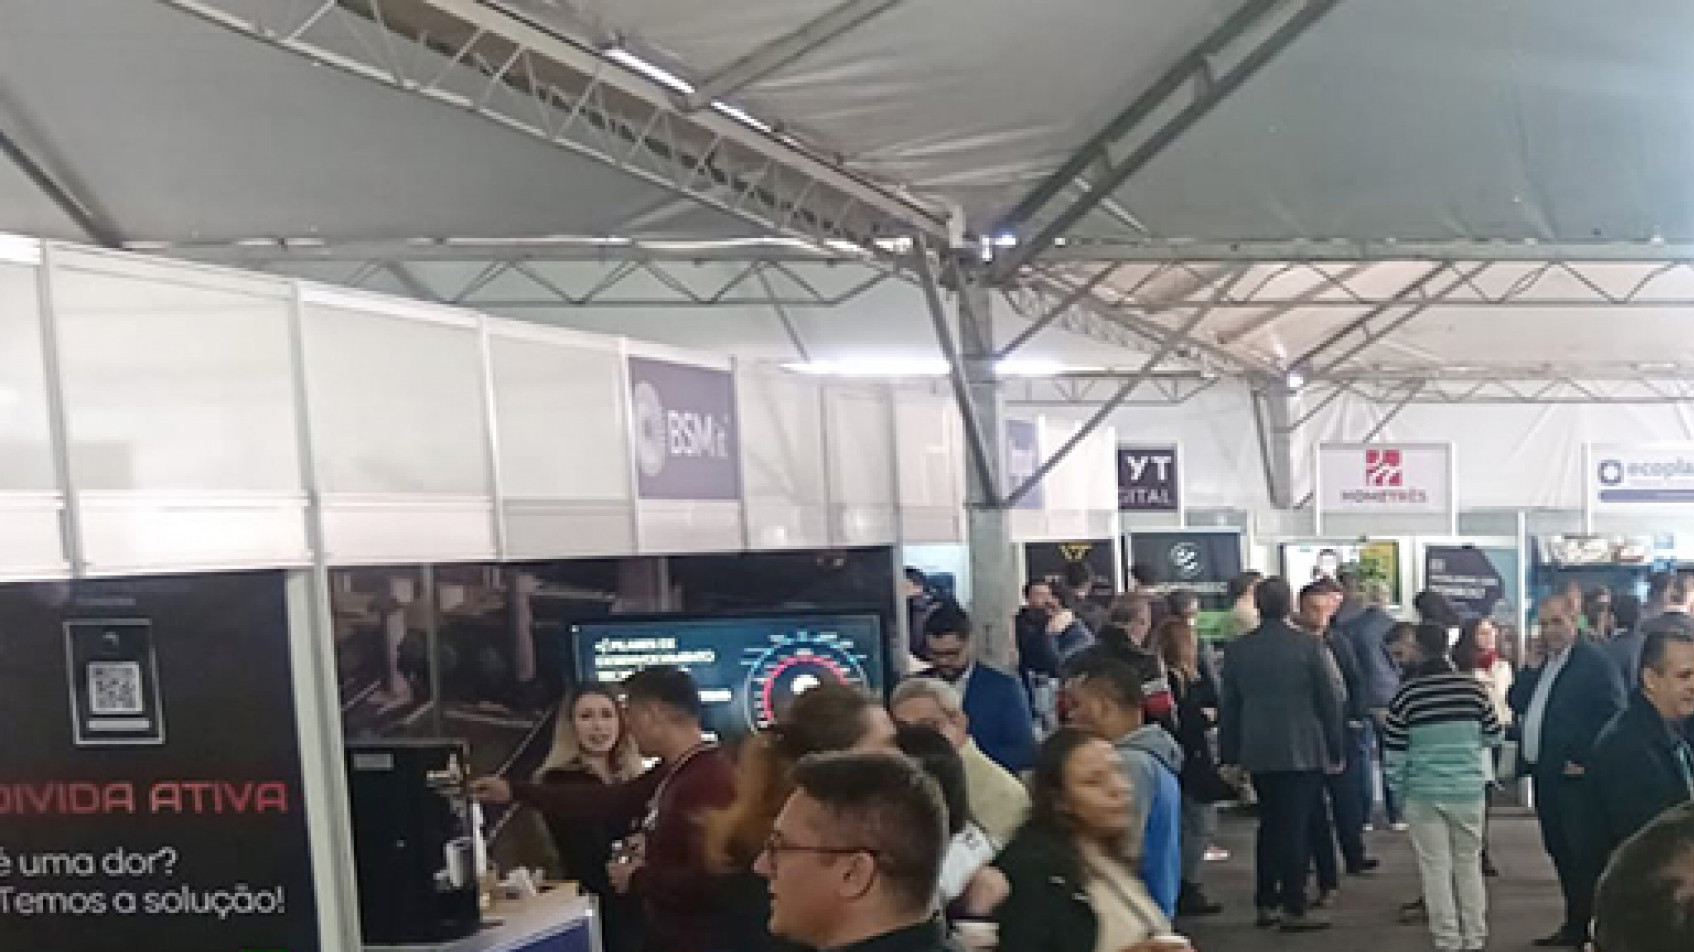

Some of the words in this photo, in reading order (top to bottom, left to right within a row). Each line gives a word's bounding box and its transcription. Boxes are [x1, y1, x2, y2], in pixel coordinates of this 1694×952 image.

[150, 780, 289, 814] ATIVA
[19, 853, 95, 877] uma
[102, 846, 179, 877] dor?
[0, 886, 107, 915] Temos
[114, 891, 137, 915] a
[144, 883, 287, 920] solução!
